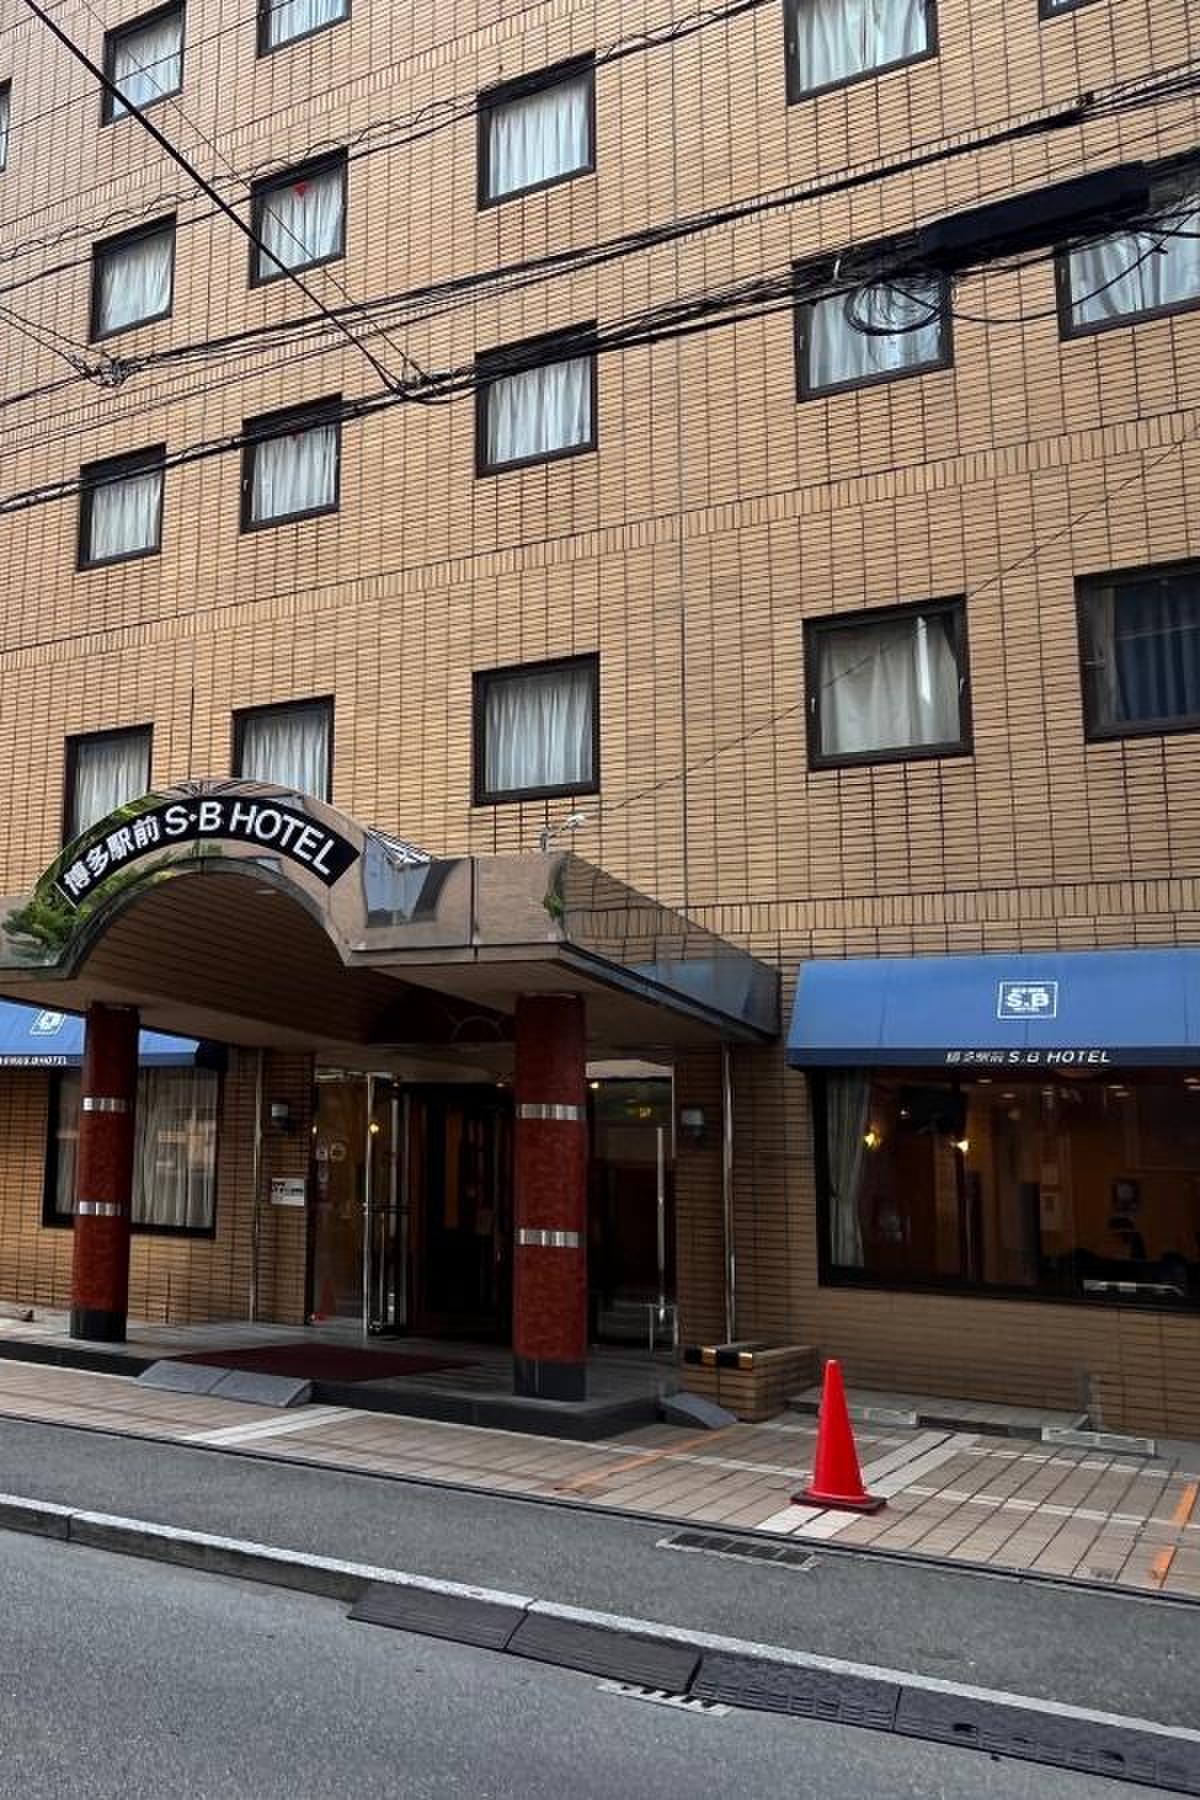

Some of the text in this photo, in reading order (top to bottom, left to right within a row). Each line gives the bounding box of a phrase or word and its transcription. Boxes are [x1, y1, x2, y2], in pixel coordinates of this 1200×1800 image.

[63, 815, 160, 896] 博多駅前
[229, 801, 337, 876] HOTEL
[1047, 1050, 1112, 1063] HOTEL
